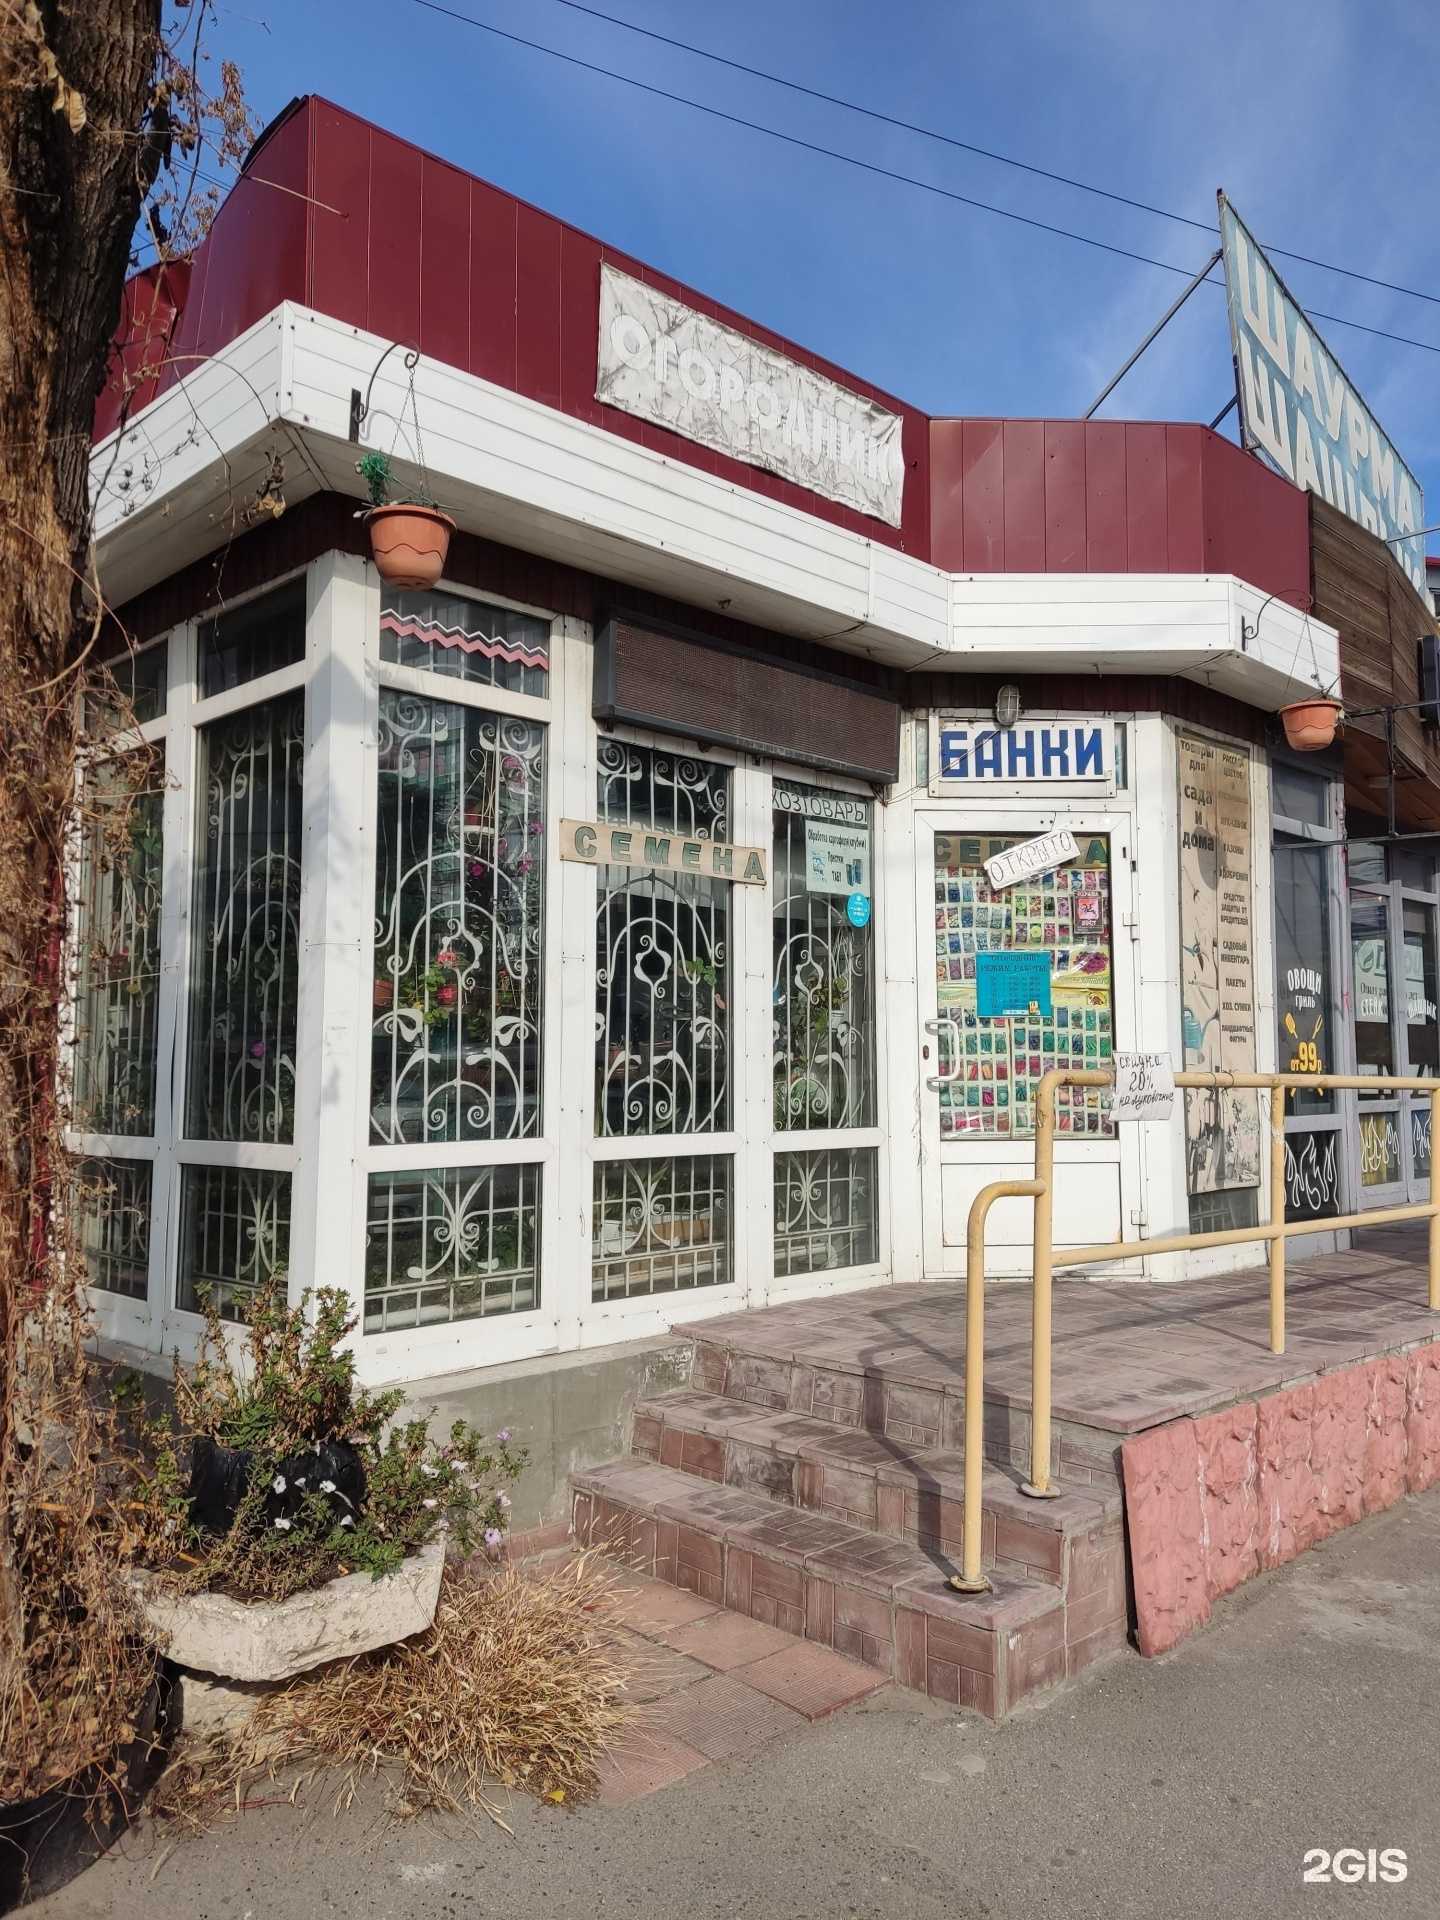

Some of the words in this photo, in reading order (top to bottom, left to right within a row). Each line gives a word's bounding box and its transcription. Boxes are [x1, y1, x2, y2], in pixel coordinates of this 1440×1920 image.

[1235, 226, 1417, 550] ШАУРМА
[940, 728, 1104, 778] БАНКИ
[1184, 784, 1213, 806] сада
[574, 826, 766, 881] СЕМЕНА
[935, 838, 1107, 864] СЕМА
[1182, 832, 1215, 852] дома
[990, 831, 1072, 882] ОТКРЫТО
[1225, 978, 1247, 988] ПАКЕТЫ
[1287, 967, 1322, 995] ОВОЩИ
[1129, 1071, 1154, 1092] 20%
